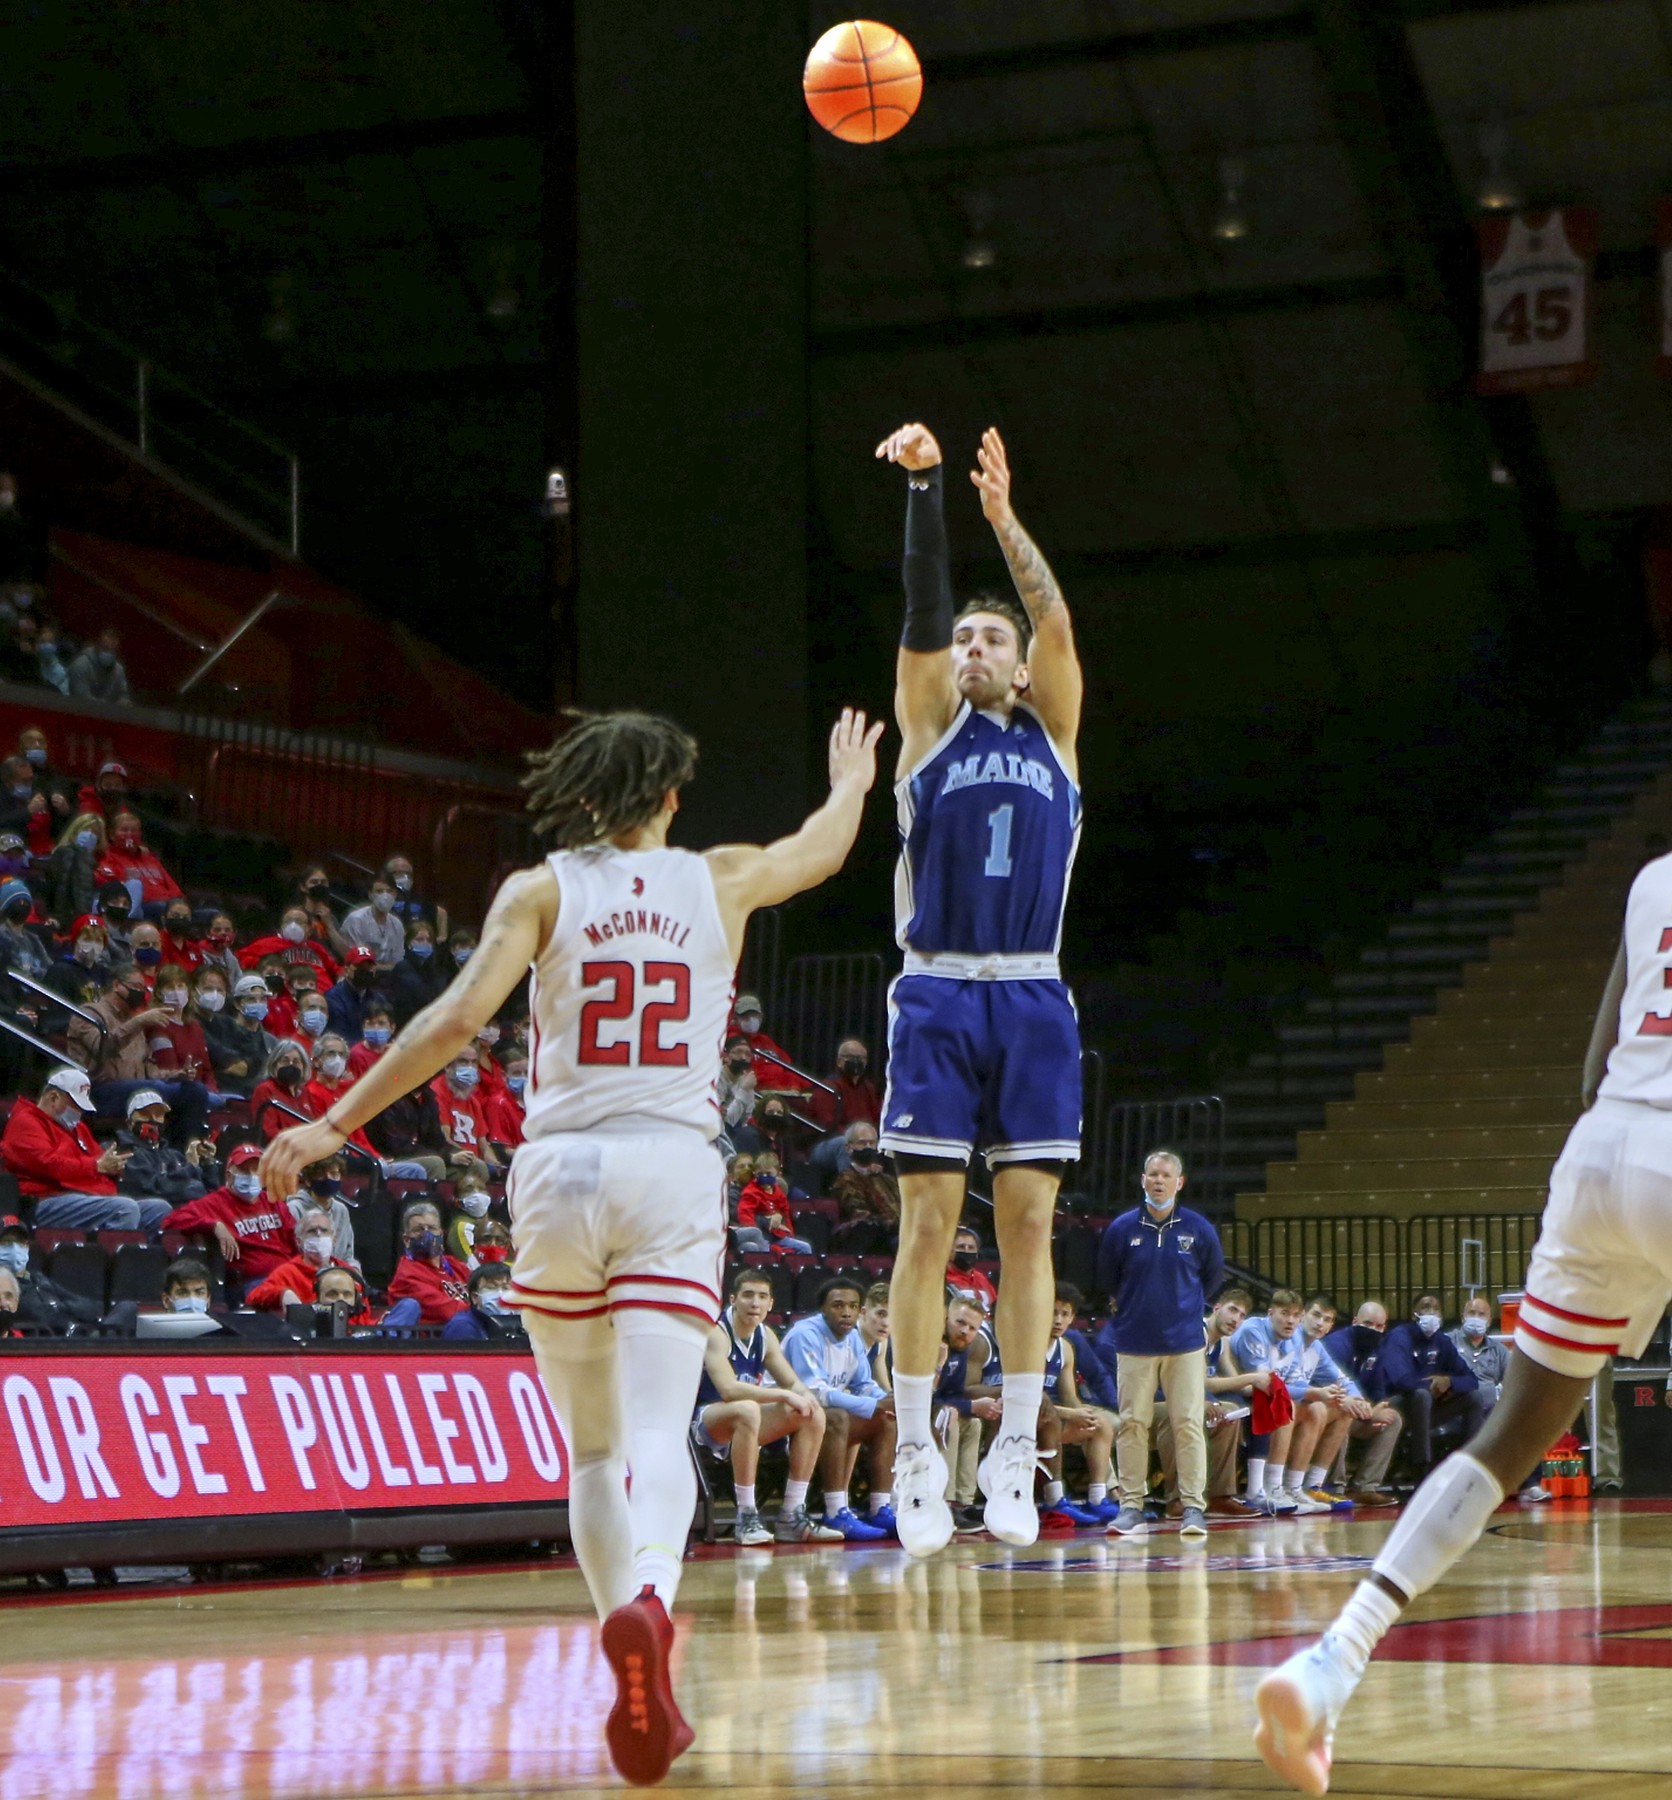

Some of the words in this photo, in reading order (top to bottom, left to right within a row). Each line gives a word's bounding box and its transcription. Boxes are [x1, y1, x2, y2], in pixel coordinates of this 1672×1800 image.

[1491, 286, 1571, 347] 45
[941, 751, 1054, 802] MAINE
[984, 802, 1015, 878] 1
[358, 946, 371, 957] R
[577, 960, 691, 1067] 22
[452, 1110, 477, 1145] R
[1633, 1386, 1656, 1407] R
[3, 1373, 121, 1504] OR
[119, 1373, 267, 1498] GET
[268, 1372, 509, 1490] PULLED
[508, 1371, 570, 1482] O
